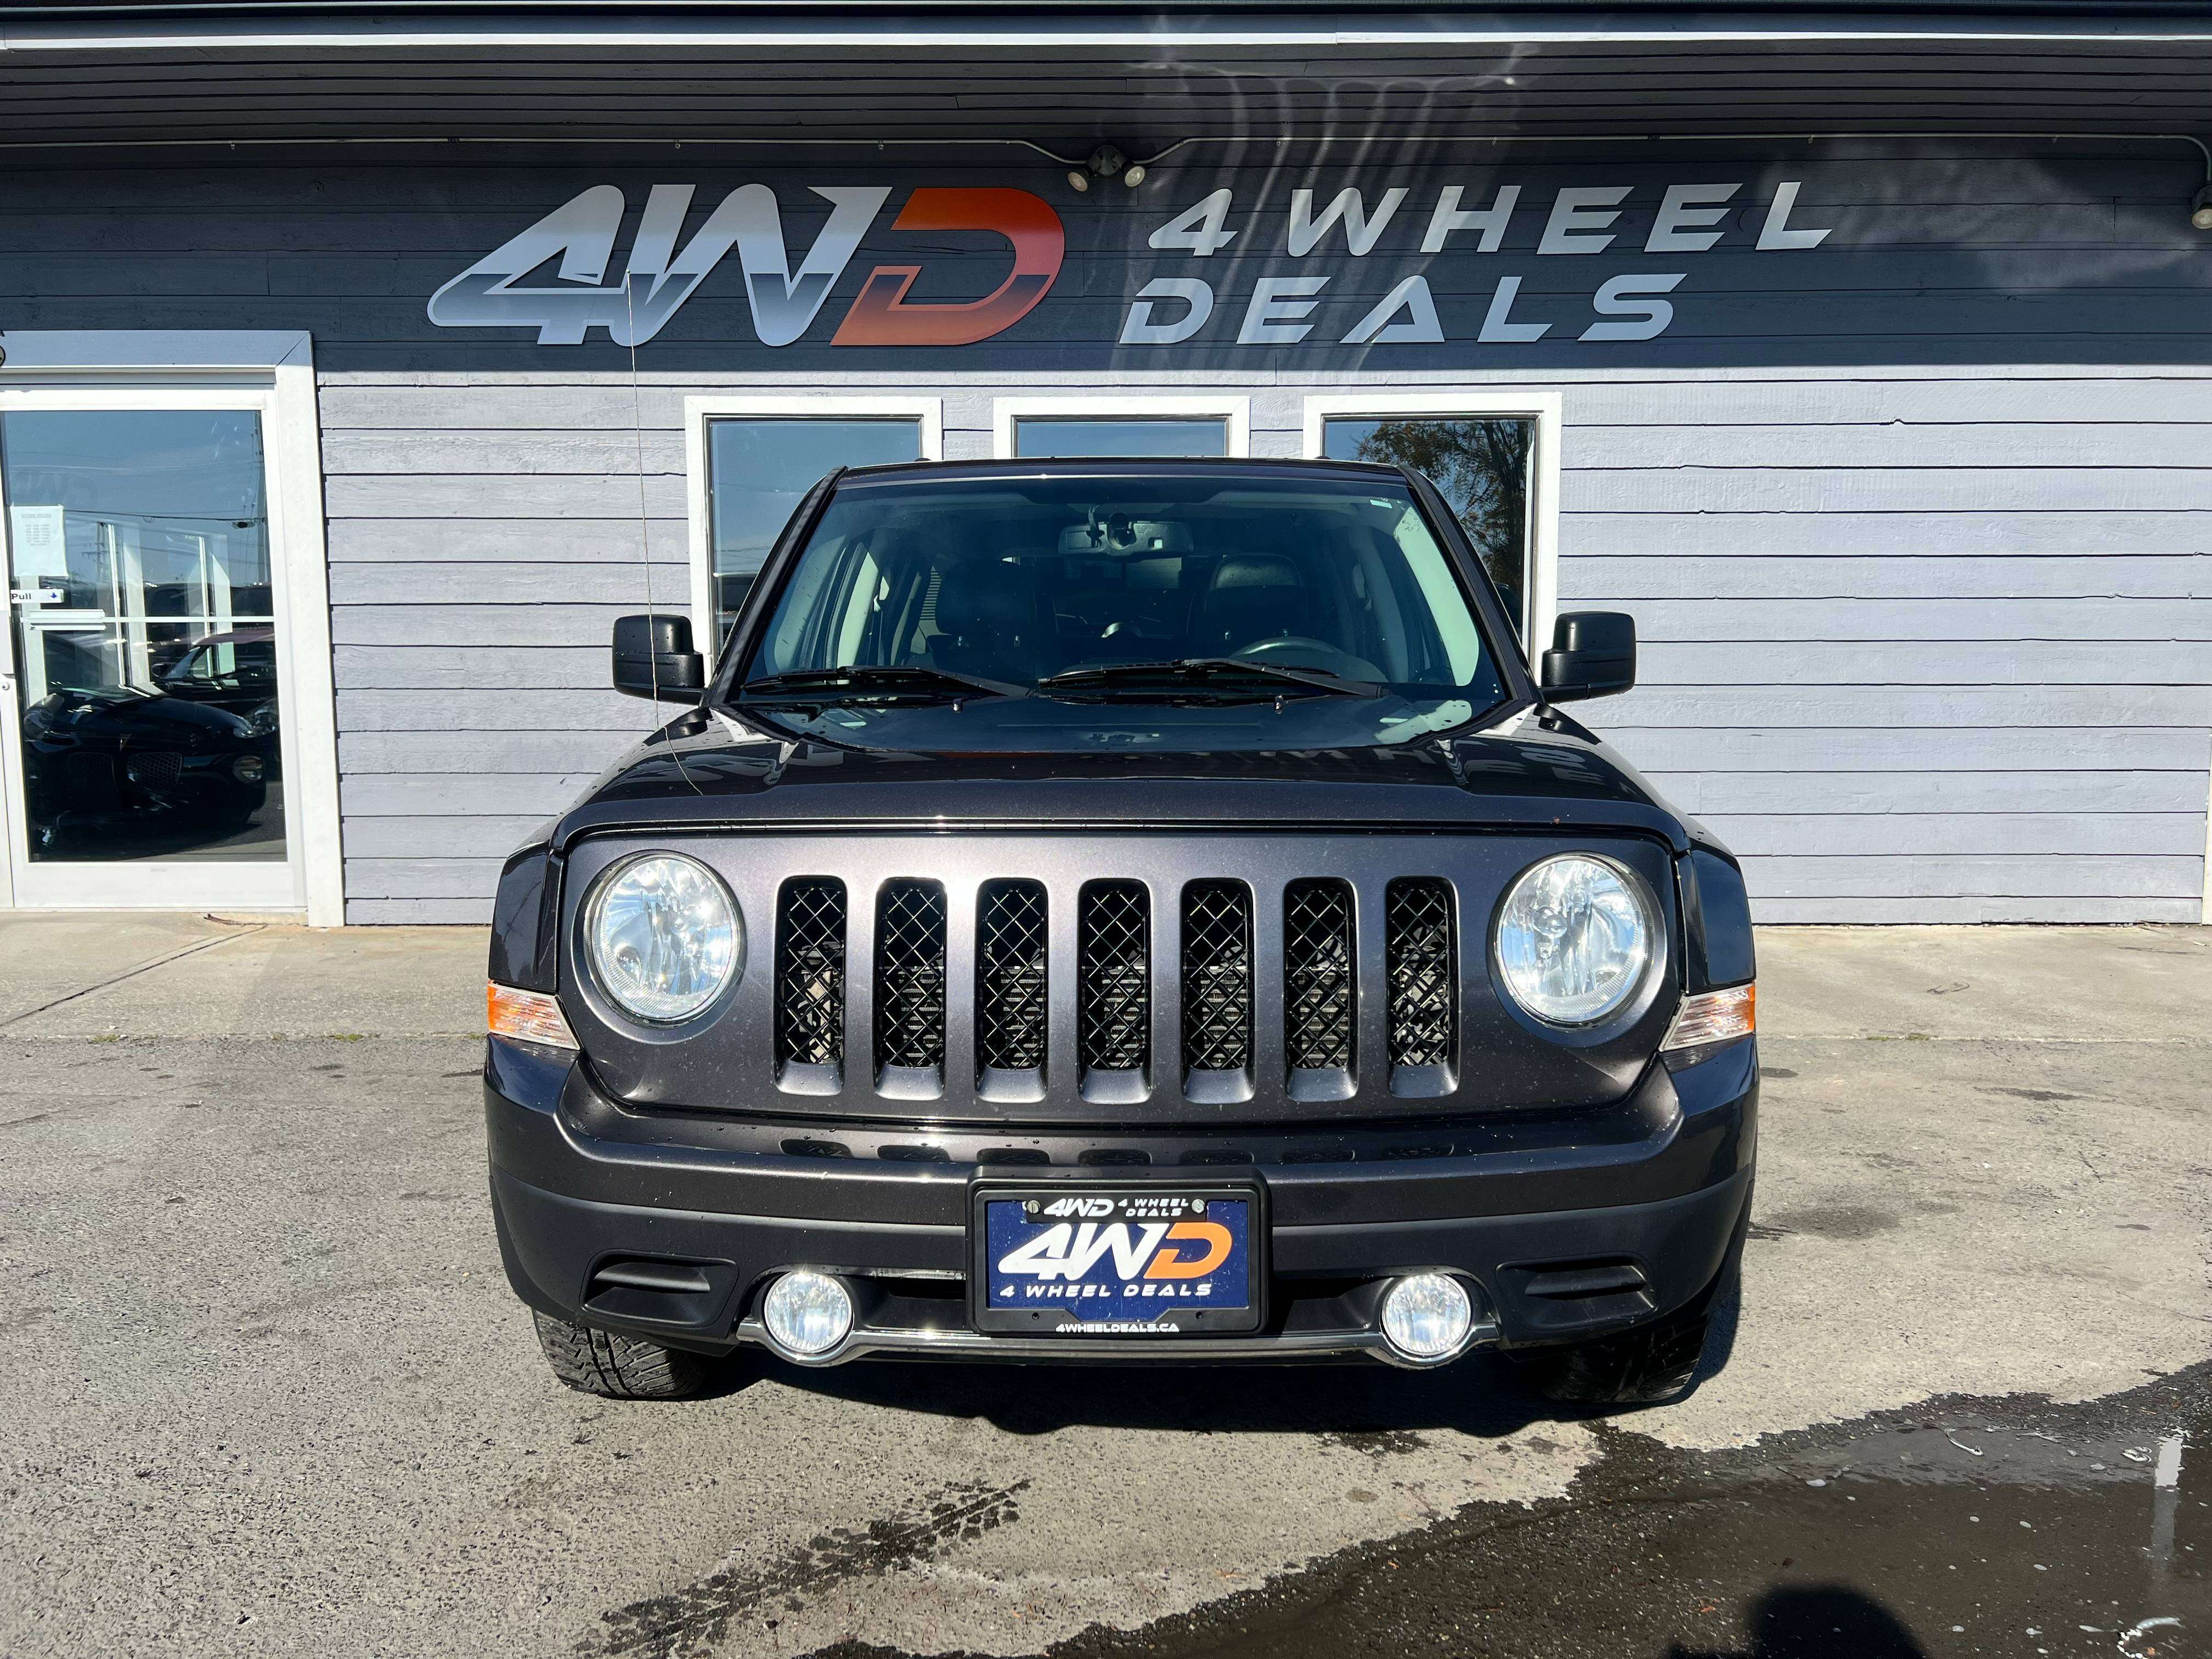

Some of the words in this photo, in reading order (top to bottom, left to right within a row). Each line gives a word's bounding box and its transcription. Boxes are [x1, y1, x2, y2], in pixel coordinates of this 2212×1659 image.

[1148, 188, 1239, 257] 4
[1287, 181, 1833, 258] WHEEL
[427, 183, 1065, 347] 4WD
[1118, 273, 1688, 346] DEALS
[1043, 1198, 1115, 1217] 4WD
[1118, 1199, 1128, 1207] 4
[1135, 1198, 1189, 1207] WHEEL
[1125, 1208, 1182, 1217] DEALS
[998, 1222, 1233, 1281] 4WD
[1000, 1285, 1015, 1298] 4
[1025, 1284, 1111, 1298] WHEEL
[1123, 1283, 1212, 1297] DEALS
[1055, 1323, 1180, 1333] 4WHEELDEALS.CA
